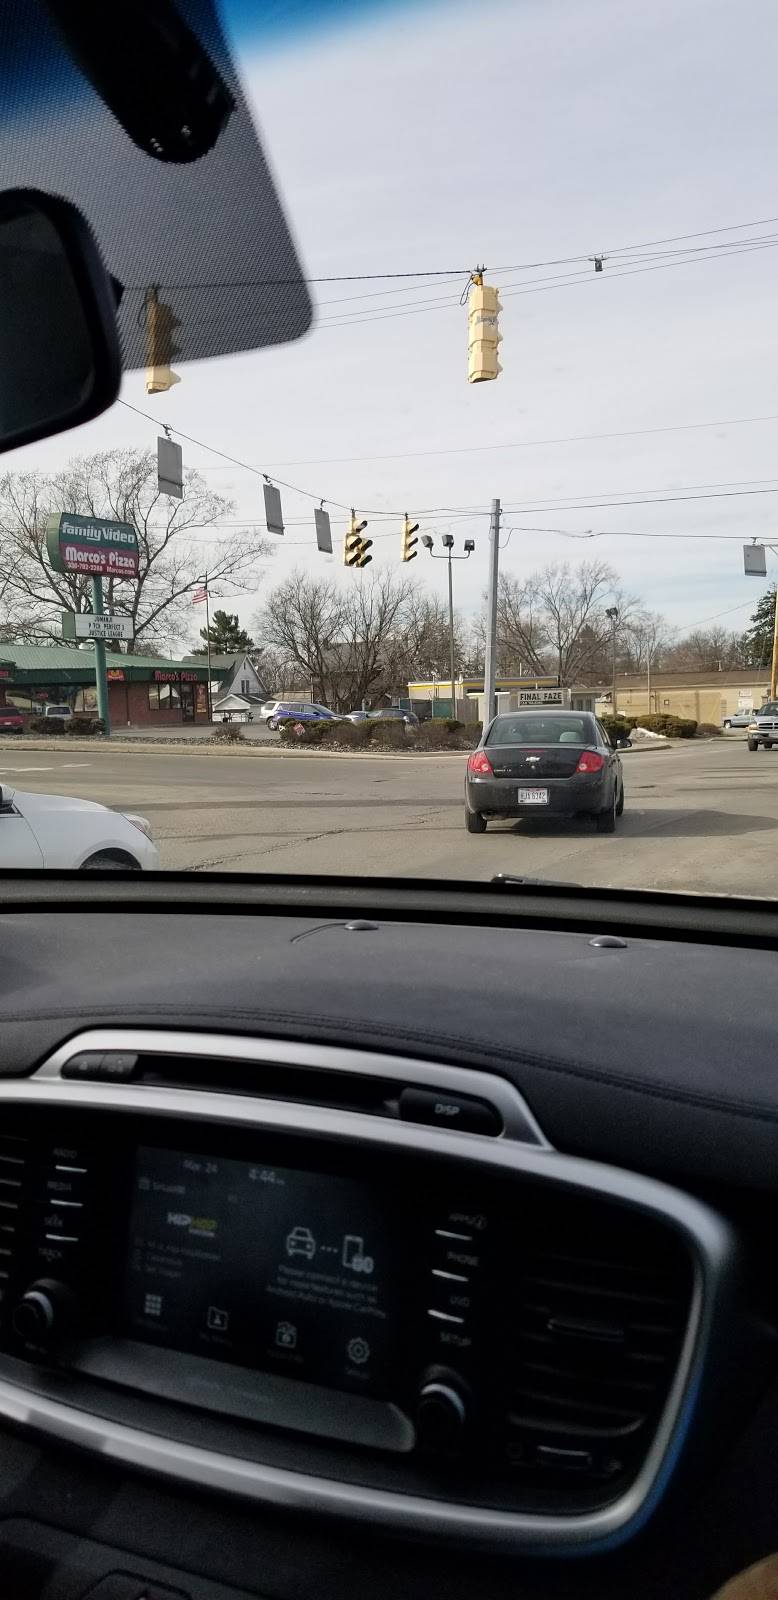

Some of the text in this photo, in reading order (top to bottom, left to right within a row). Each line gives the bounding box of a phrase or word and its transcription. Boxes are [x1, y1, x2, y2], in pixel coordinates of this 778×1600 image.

[65, 546, 136, 569] Marco's Pizza
[88, 629, 123, 638] JUSTICE LEAGUE
[154, 671, 198, 681] Marco's Pizza
[520, 692, 563, 701] FINAL FAZE
[434, 1103, 460, 1116] DISP
